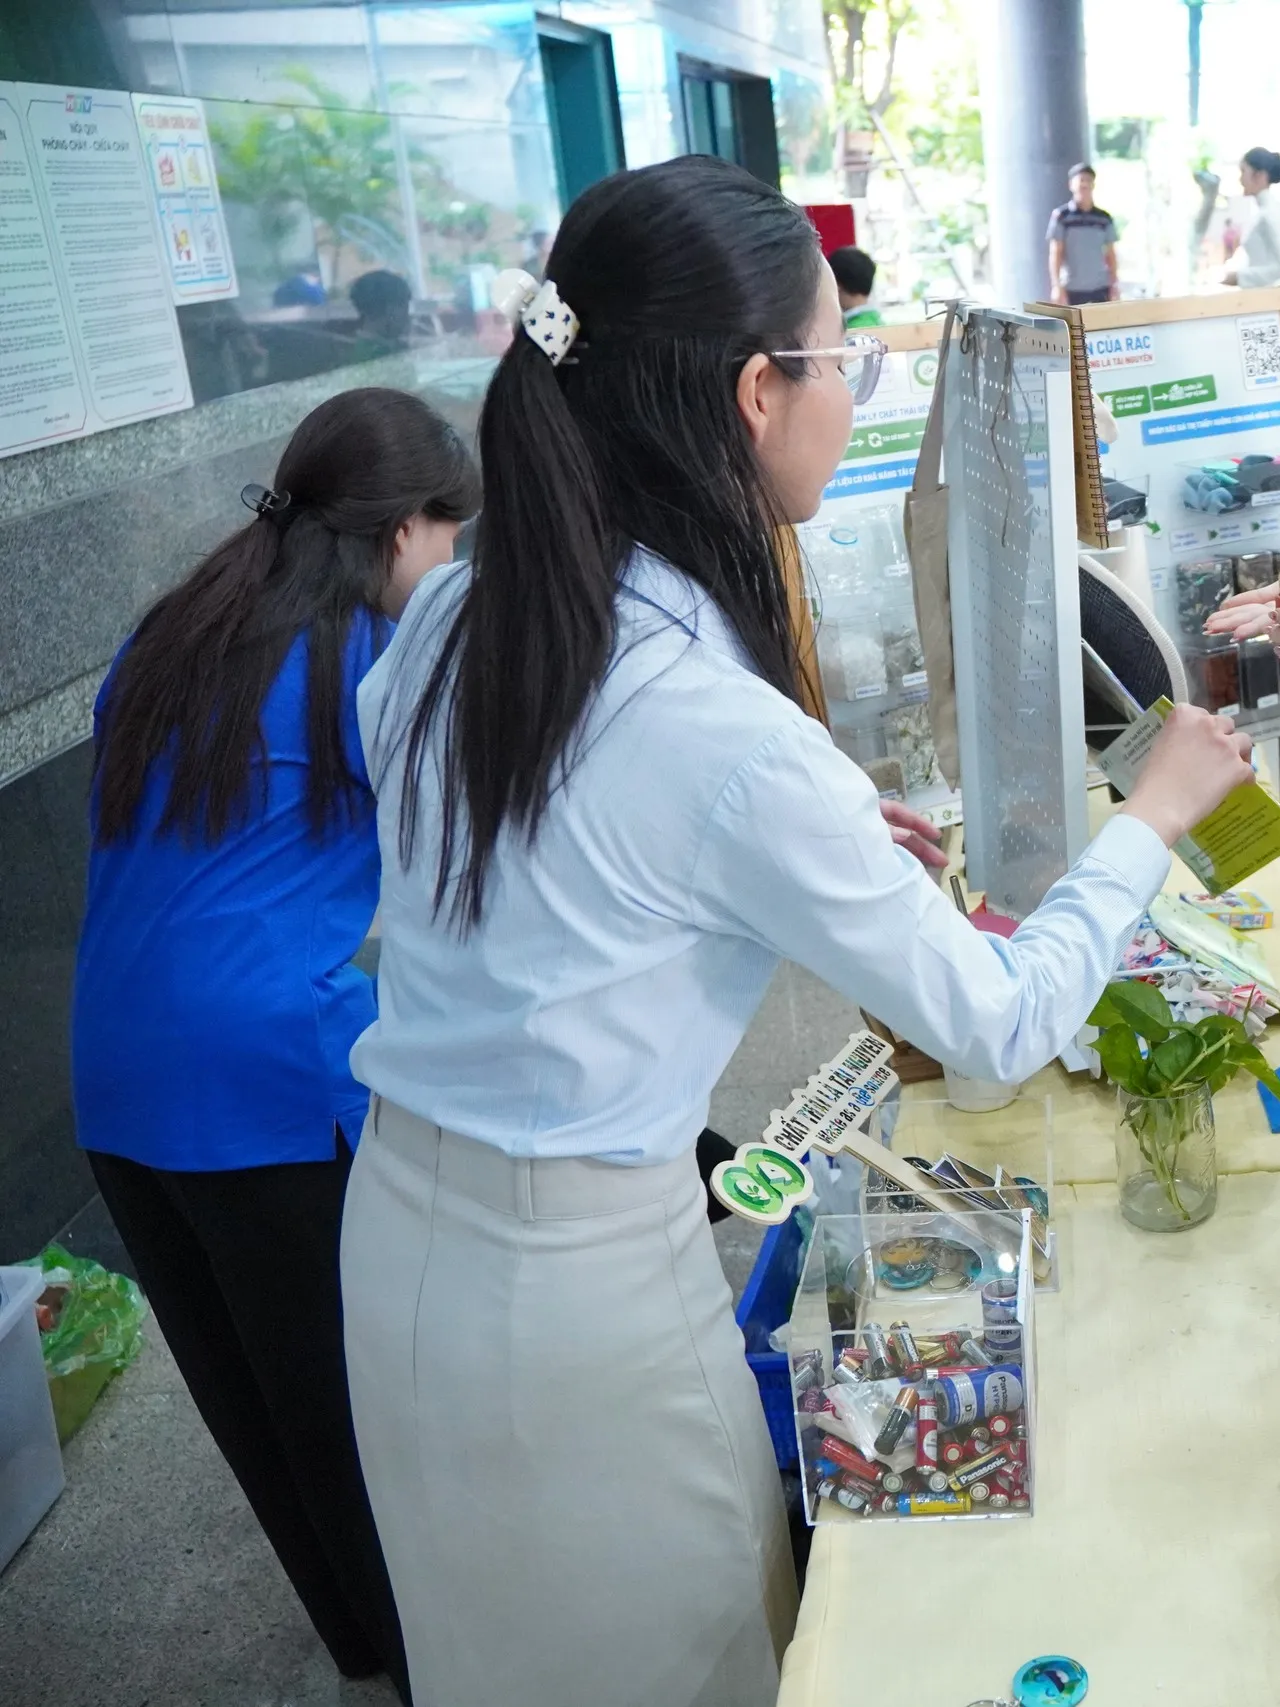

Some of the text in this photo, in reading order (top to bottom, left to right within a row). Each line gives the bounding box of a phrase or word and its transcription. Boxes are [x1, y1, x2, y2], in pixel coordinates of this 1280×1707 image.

[66, 94, 92, 113] HTV
[1096, 335, 1123, 354] CỦA
[1125, 333, 1151, 351] RÁC
[773, 1035, 886, 1152] CHẤT THẢI LÀ TÀI NGUYÊN
[816, 1117, 848, 1145] Waste
[839, 1108, 857, 1122] as
[848, 1101, 861, 1112] a
[998, 1375, 1009, 1410] Panaso
[959, 1456, 1007, 1486] Panasonic
